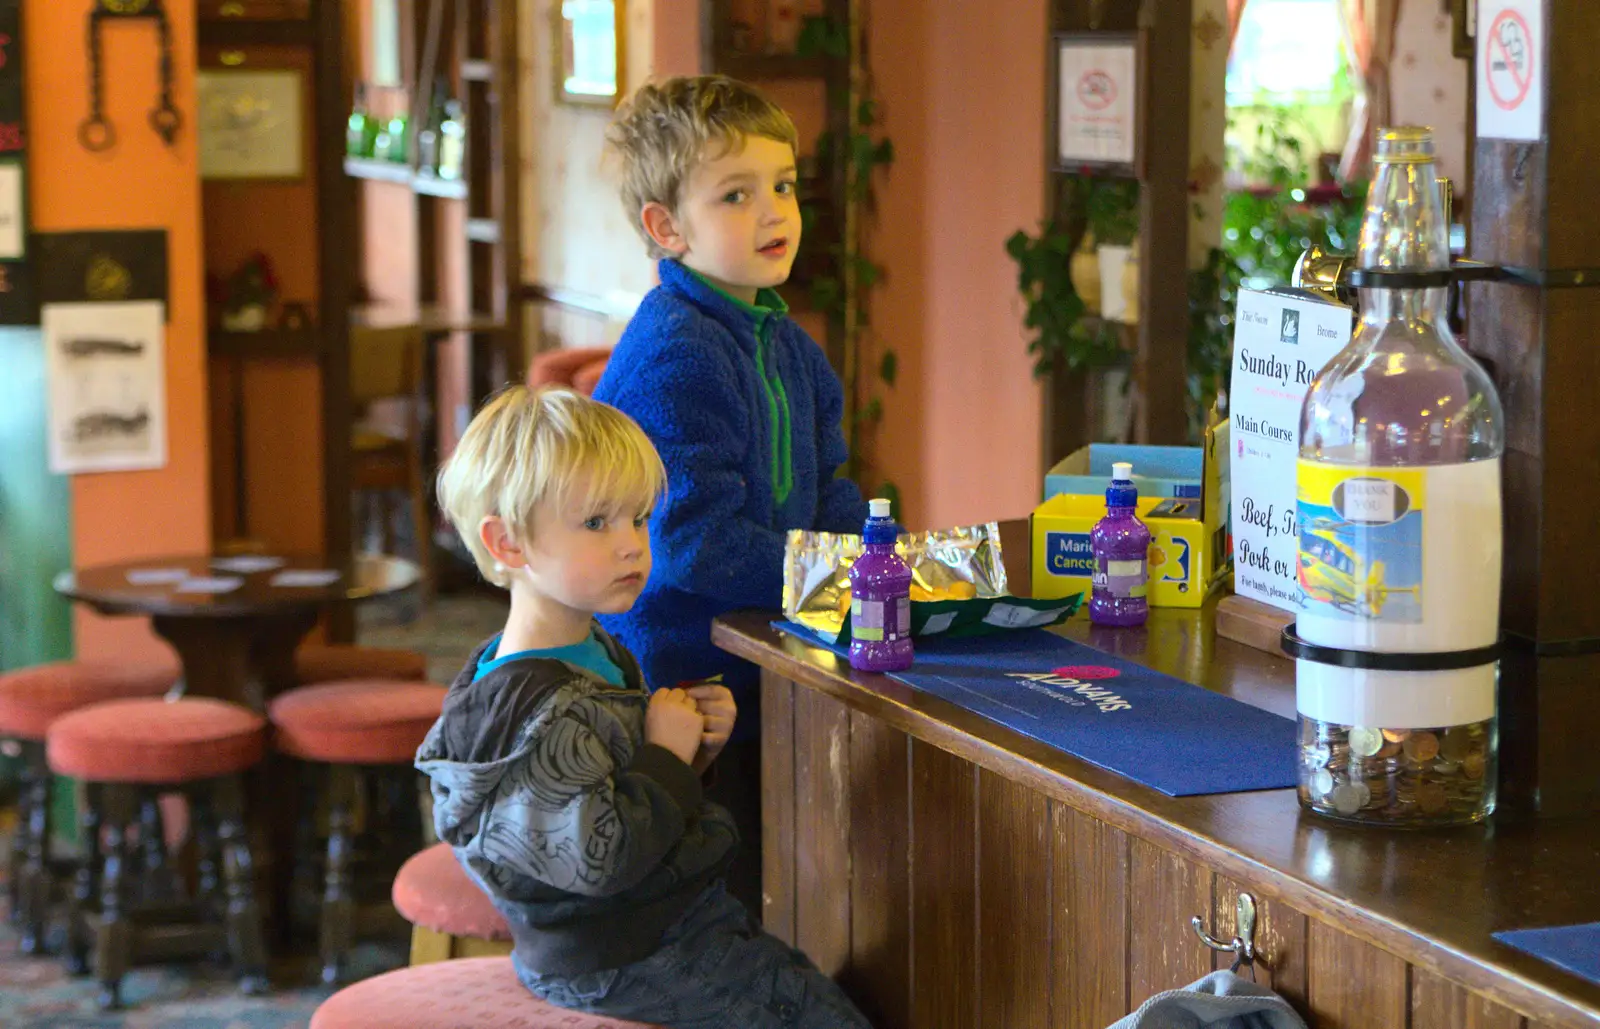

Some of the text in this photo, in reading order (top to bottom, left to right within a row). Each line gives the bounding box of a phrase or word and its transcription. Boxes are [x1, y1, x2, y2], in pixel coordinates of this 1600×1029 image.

[1317, 324, 1338, 339] Brome
[1240, 348, 1291, 387] Sunday
[1235, 413, 1293, 442] Main Course
[1241, 497, 1278, 537] Beef,
[1354, 499, 1381, 512] YOU
[1054, 554, 1093, 570] Cance
[1239, 539, 1289, 578] Pork or
[1003, 672, 1132, 713] ADNAMS
